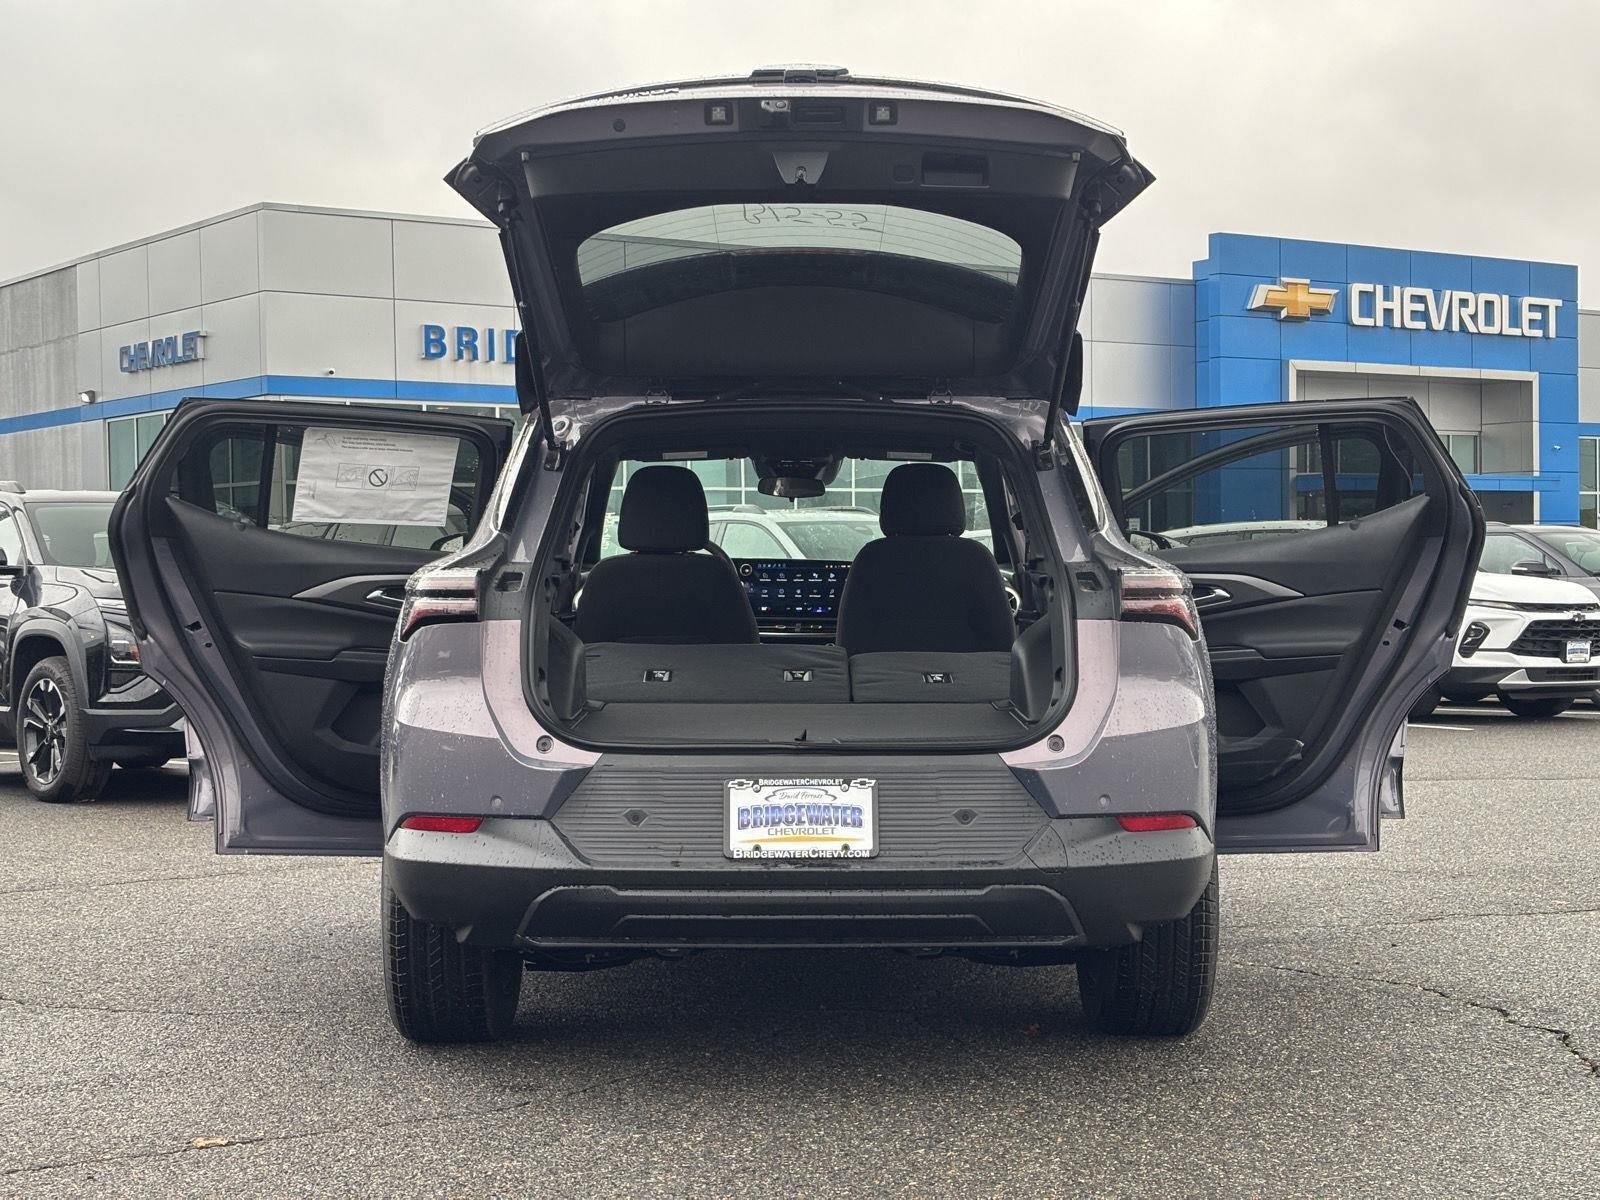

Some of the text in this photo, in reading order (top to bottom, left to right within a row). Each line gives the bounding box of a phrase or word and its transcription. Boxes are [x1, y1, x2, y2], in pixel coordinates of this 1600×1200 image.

[1350, 282, 1563, 338] CHEVROLET
[119, 331, 207, 373] CHEVROLET
[737, 802, 864, 830] BRIDGEWATER
[767, 827, 836, 836] CHEVROLET
